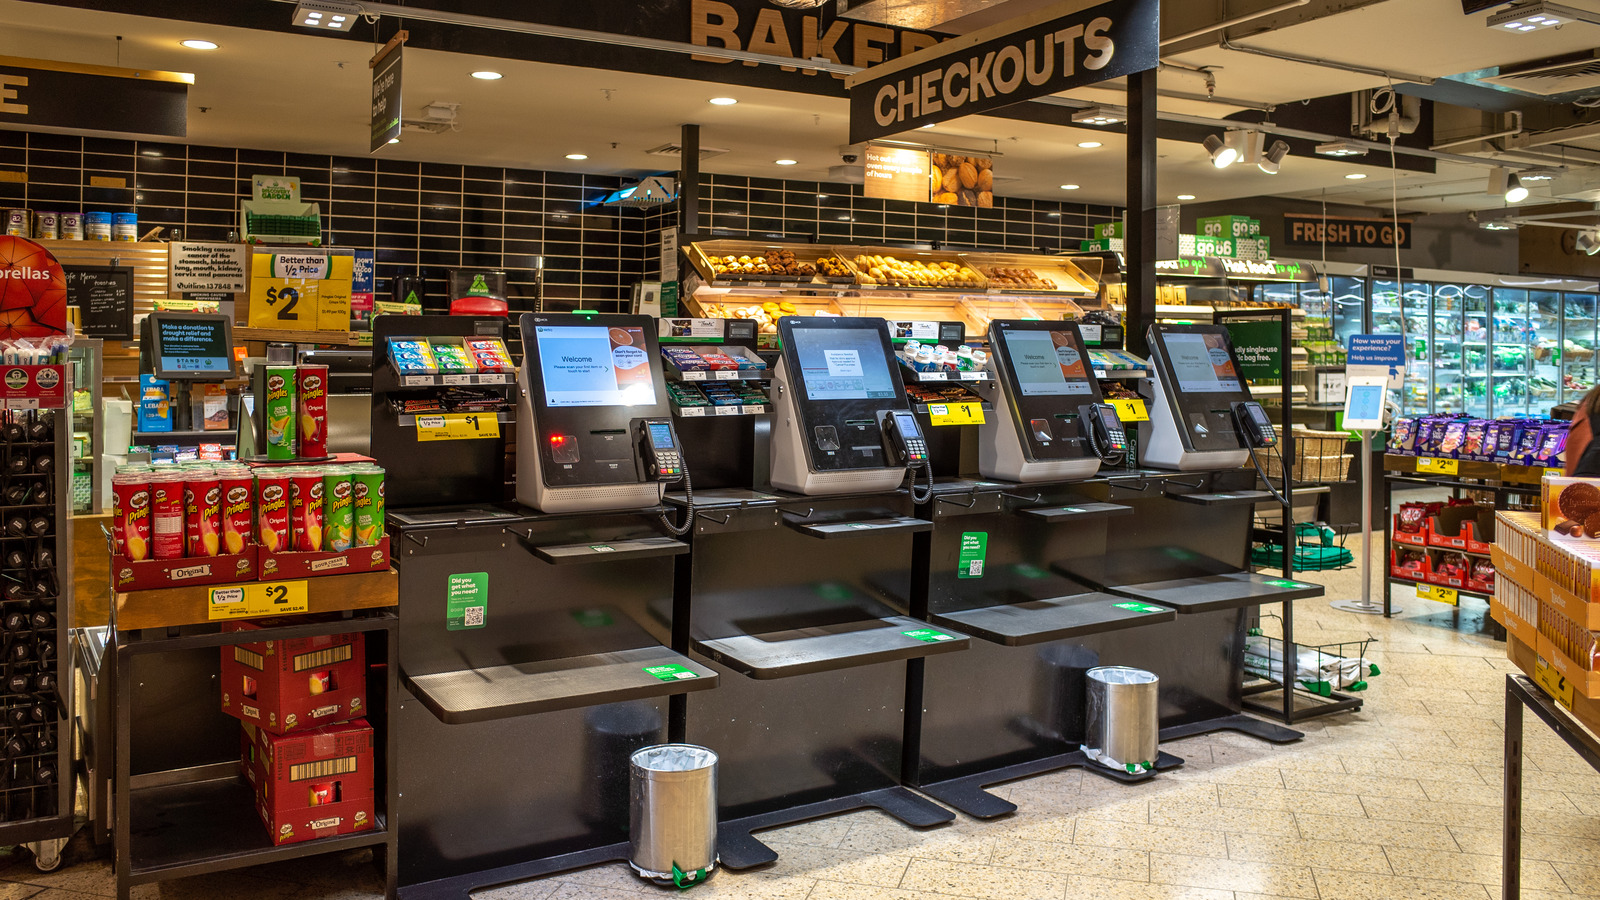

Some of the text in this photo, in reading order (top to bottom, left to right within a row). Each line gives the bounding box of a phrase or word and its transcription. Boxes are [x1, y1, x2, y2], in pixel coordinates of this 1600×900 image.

[690, 0, 941, 80] BAKE
[874, 17, 1114, 126] CHECKOUTS
[874, 170, 892, 178] hours
[1232, 222, 1248, 236] go
[1292, 222, 1406, 245] FRESH TO GO
[1197, 242, 1214, 256] go
[285, 265, 297, 276] 1/2
[1221, 258, 1302, 280] Hot food to go!
[80, 272, 97, 284] Menu
[266, 286, 299, 320] $2
[1246, 346, 1278, 354] single-use
[302, 388, 323, 405] Pringles
[961, 405, 972, 417] $1
[1126, 404, 1136, 414] $1
[465, 416, 479, 430] $1
[225, 501, 250, 519] Pringles
[262, 500, 286, 516] Pringles
[176, 567, 204, 578] Original
[266, 585, 288, 604] $2
[315, 819, 336, 828] Original
